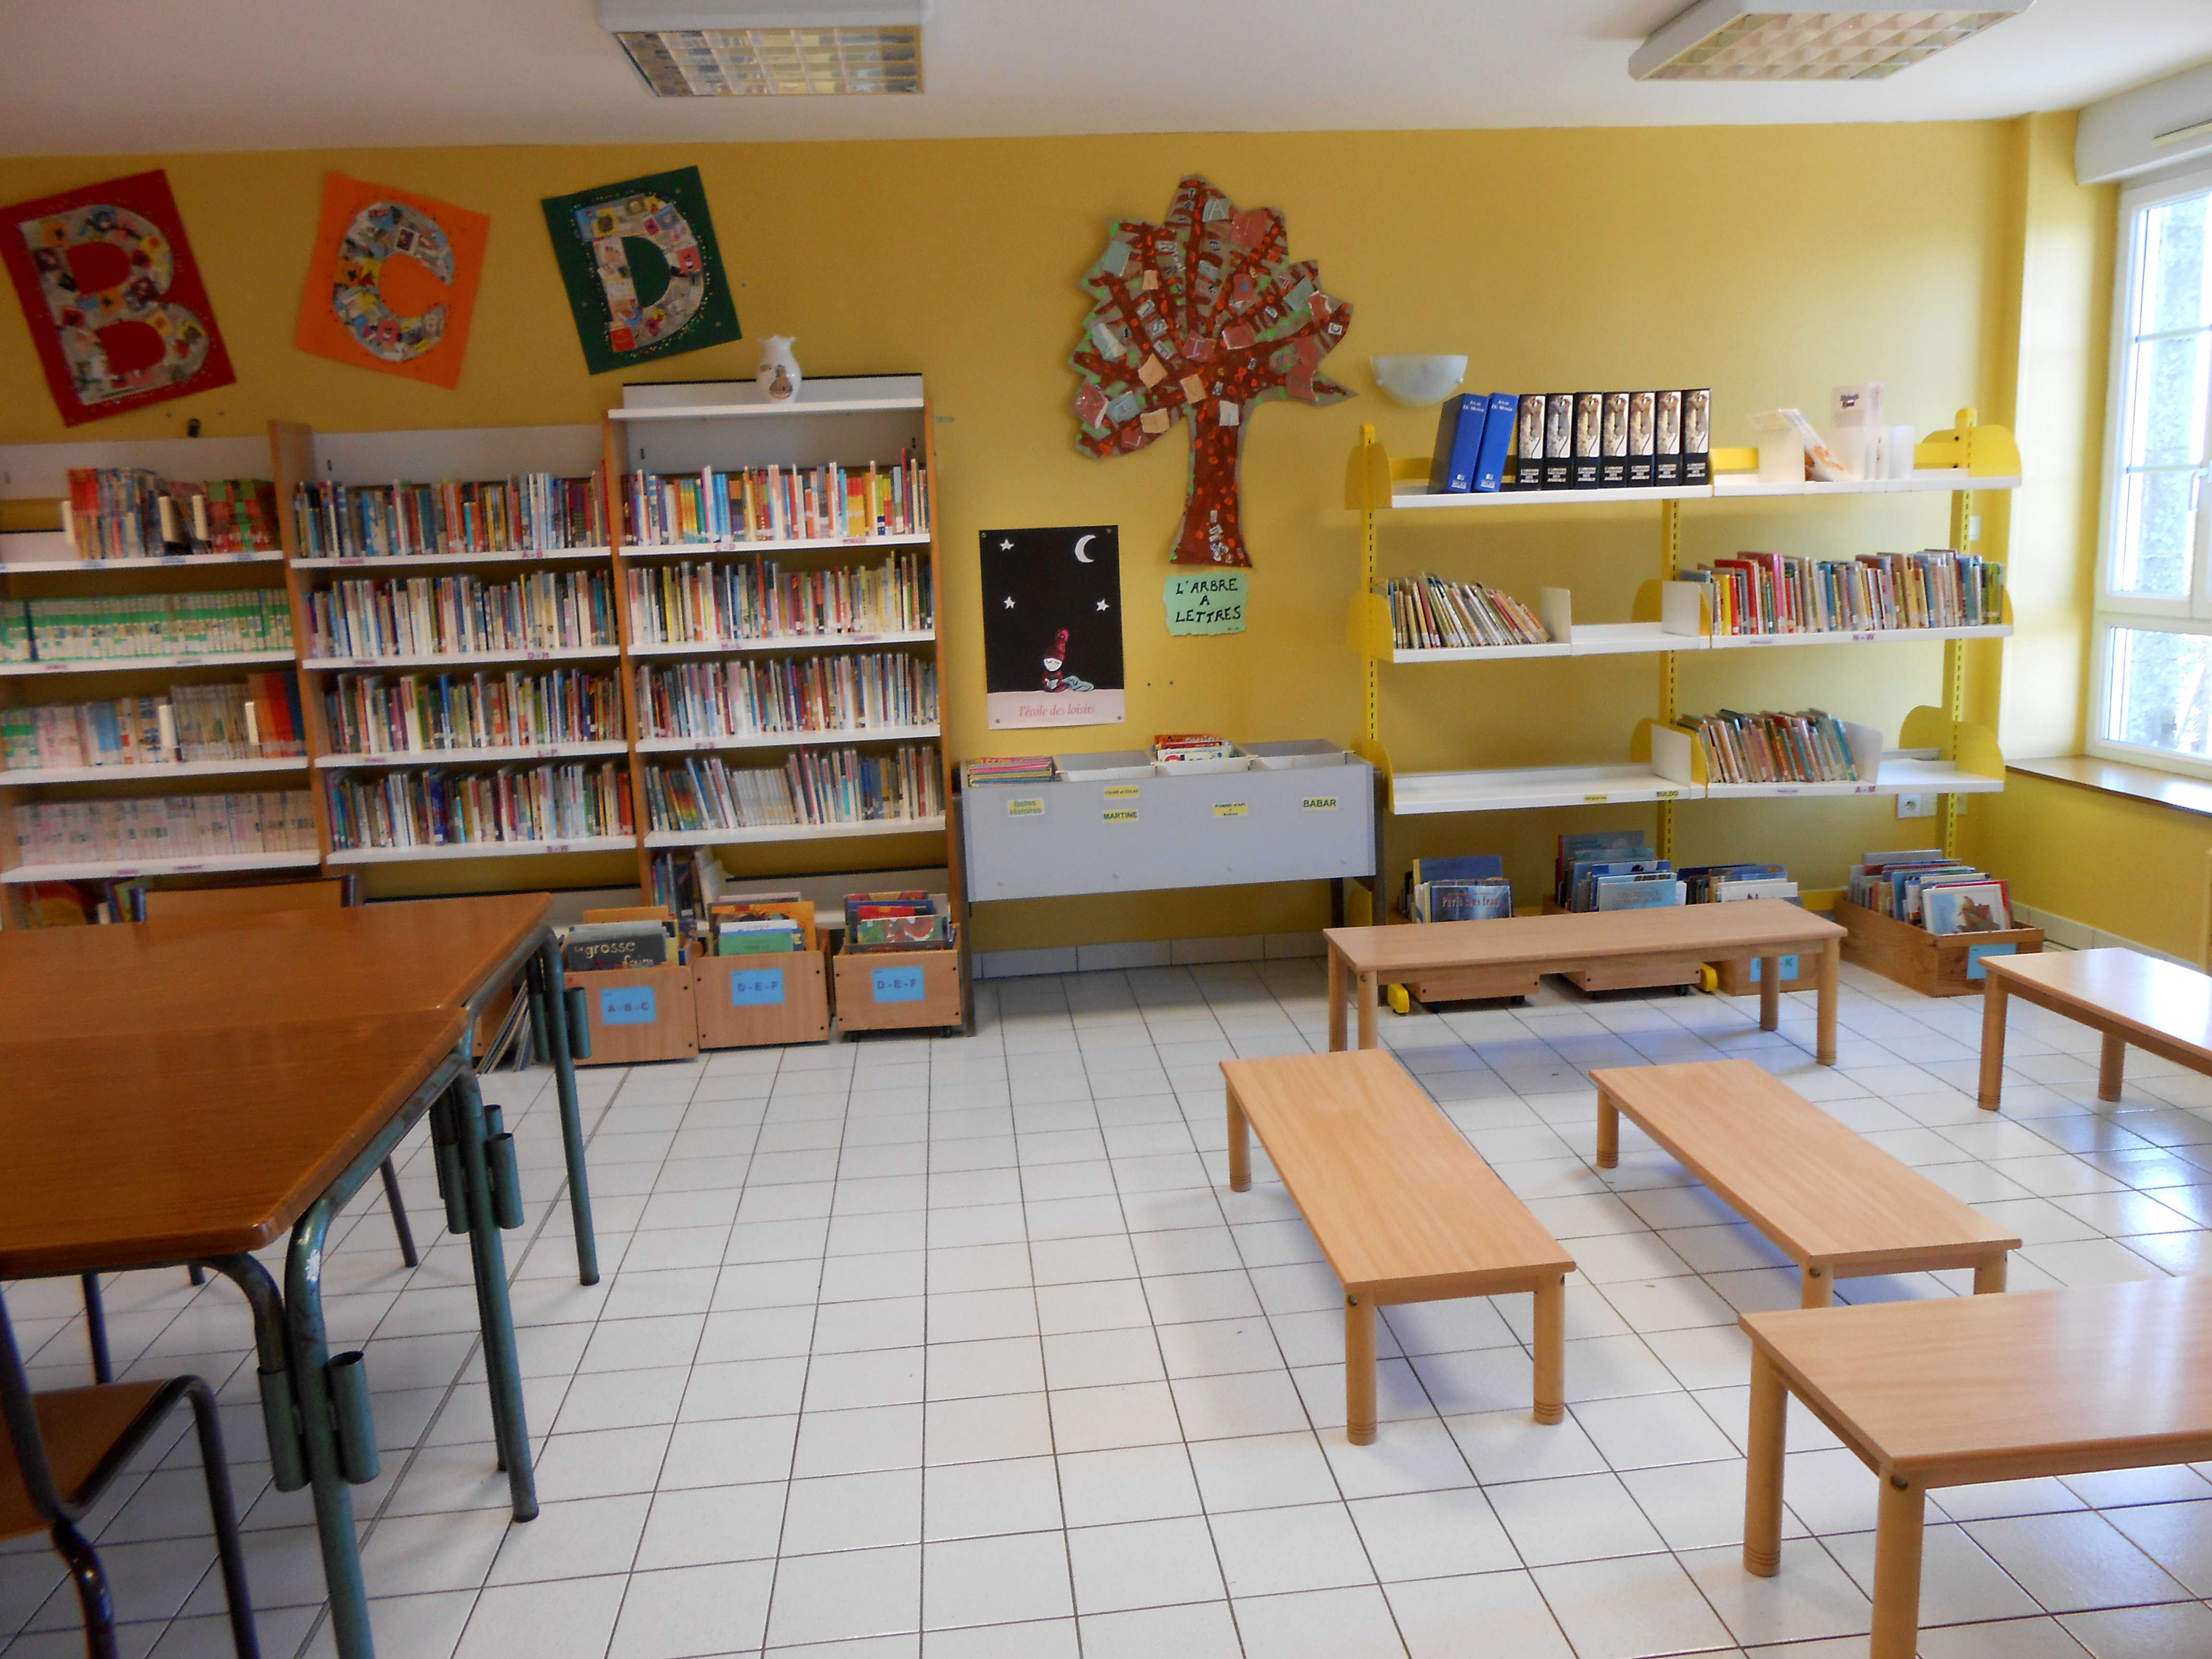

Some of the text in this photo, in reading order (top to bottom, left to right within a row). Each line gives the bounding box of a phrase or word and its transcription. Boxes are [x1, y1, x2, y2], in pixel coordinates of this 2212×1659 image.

[19, 193, 704, 405] B C D
[1176, 578, 1238, 595] L'ARBRE
[1200, 595, 1210, 606] A
[1176, 605, 1241, 623] LETTRES
[1020, 703, 1095, 717] l'école des loisirs
[1303, 799, 1337, 808] BABAR
[585, 941, 636, 959] grosse
